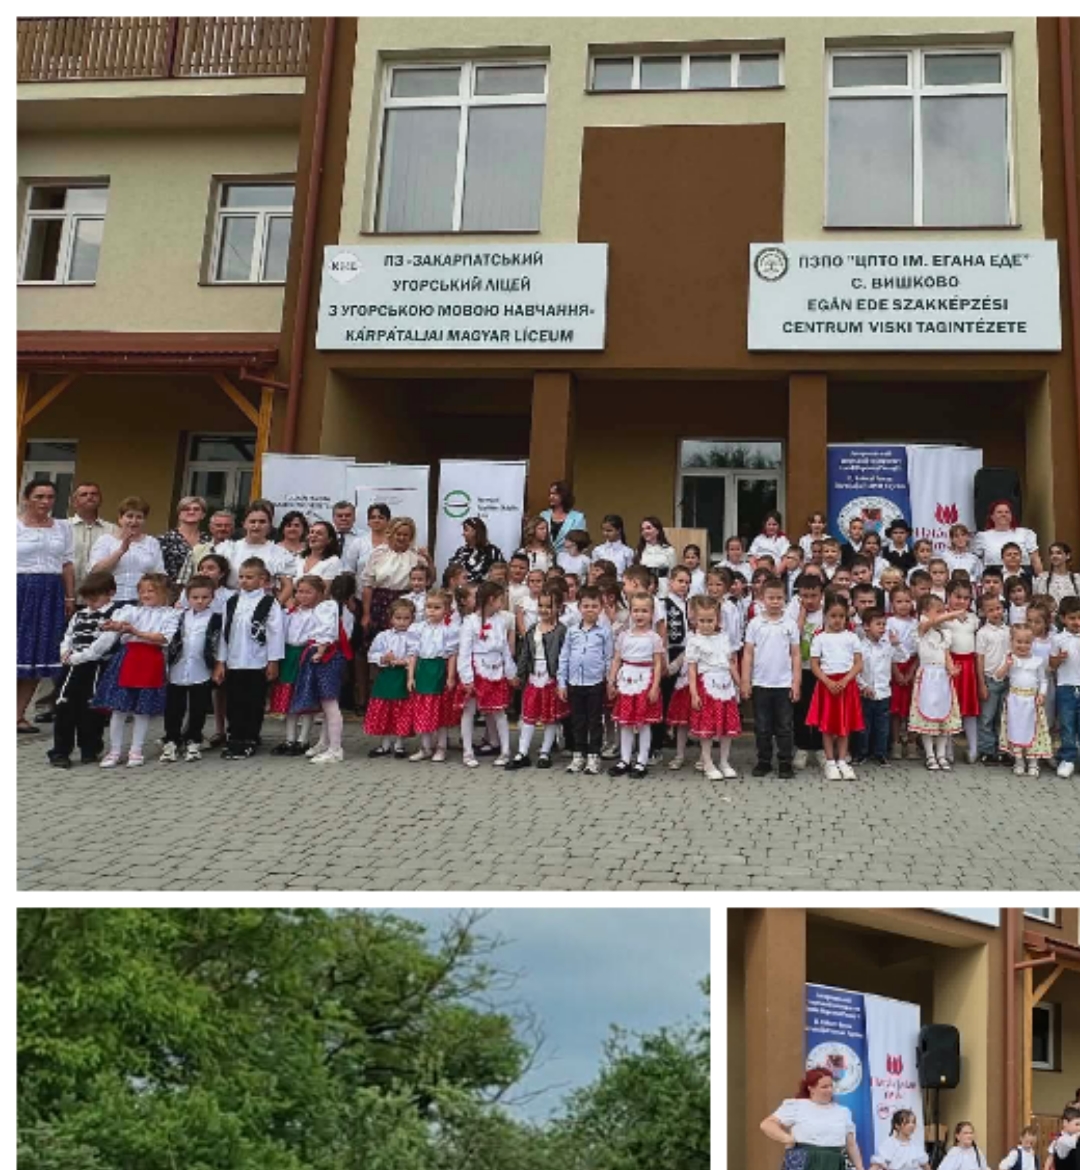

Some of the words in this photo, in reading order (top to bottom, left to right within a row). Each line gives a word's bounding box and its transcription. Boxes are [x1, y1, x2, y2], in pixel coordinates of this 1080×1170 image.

[383, 255, 404, 267] ПЗ
[799, 255, 844, 268] ПЗПО
[932, 255, 985, 267] ЕГАНА
[392, 277, 482, 292] УГОРСЬКИЙ
[485, 277, 531, 293] ЛІЦЕЙ
[851, 277, 867, 289] С.
[871, 276, 959, 289] ВИШКОВО
[807, 297, 852, 311] EGÁN
[856, 298, 889, 311] EDE
[892, 295, 1009, 311] SZAKKÉPZÉSI
[341, 304, 434, 317] УГОРСЬКОЮ
[438, 305, 499, 317] МОВОЮ
[782, 321, 863, 333] CENTRUM
[869, 321, 912, 333] VISKI
[916, 317, 1027, 333] TAGINTÉZETE
[448, 329, 510, 342] MAGYAR
[514, 326, 574, 342] LÍCEUM
